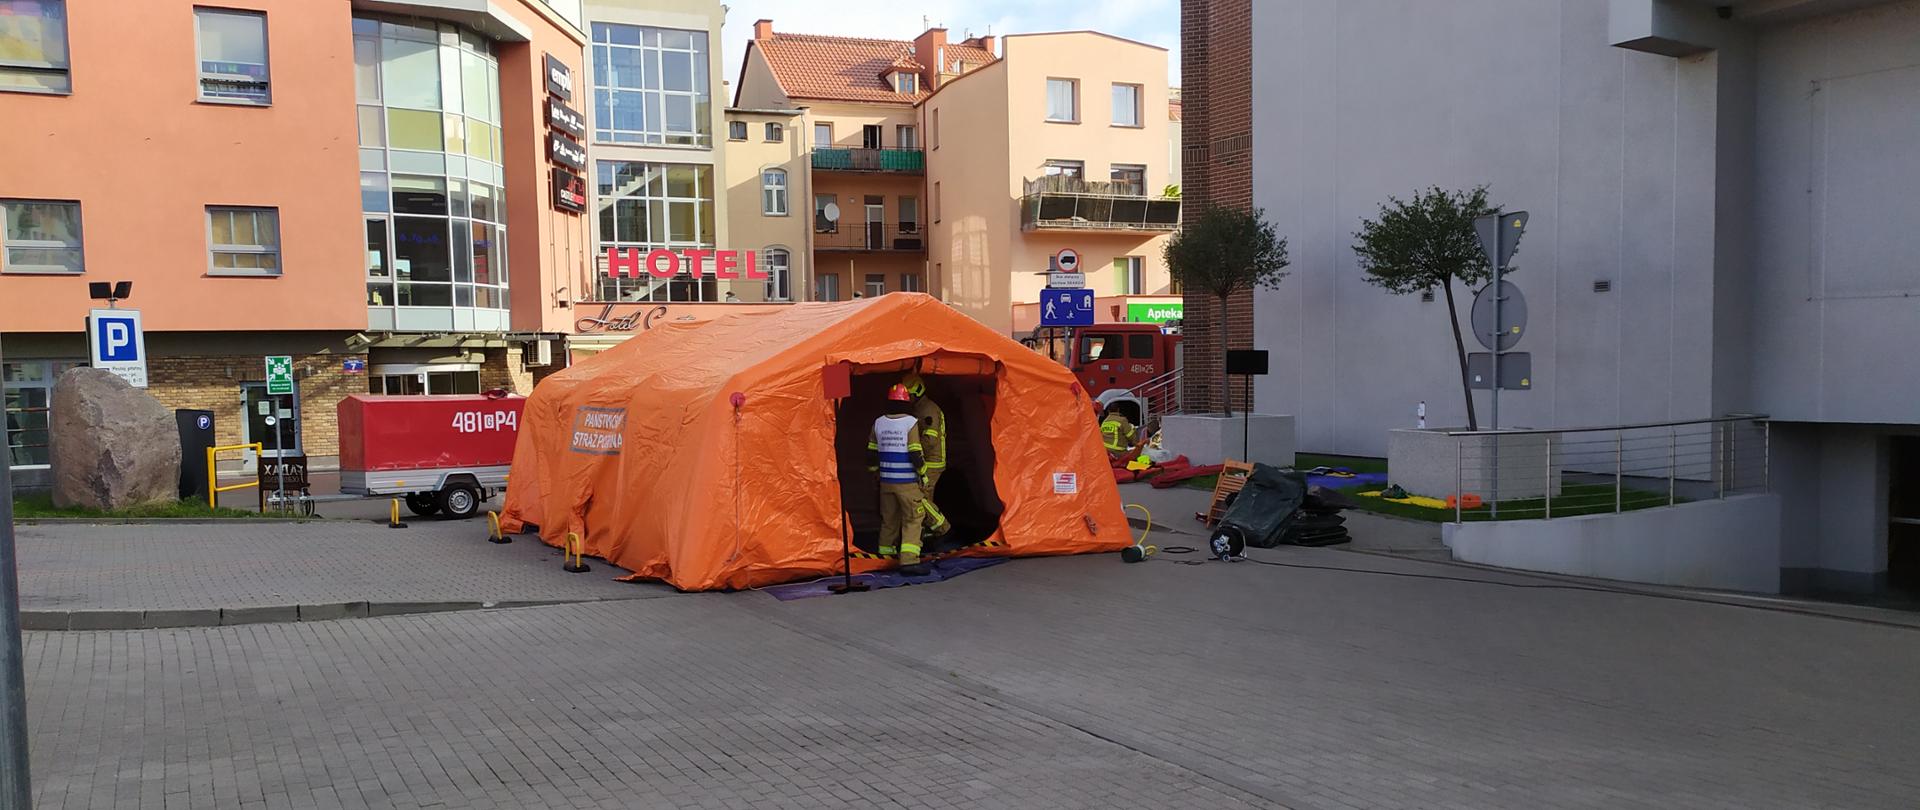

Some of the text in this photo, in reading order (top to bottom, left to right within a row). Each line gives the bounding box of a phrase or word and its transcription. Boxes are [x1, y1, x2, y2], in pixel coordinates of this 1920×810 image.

[607, 247, 769, 280] HOTEL
[575, 303, 642, 333] Hotel
[1147, 308, 1183, 321] Apteka
[106, 322, 129, 356] P
[350, 363, 357, 371] 7
[201, 418, 208, 428] P
